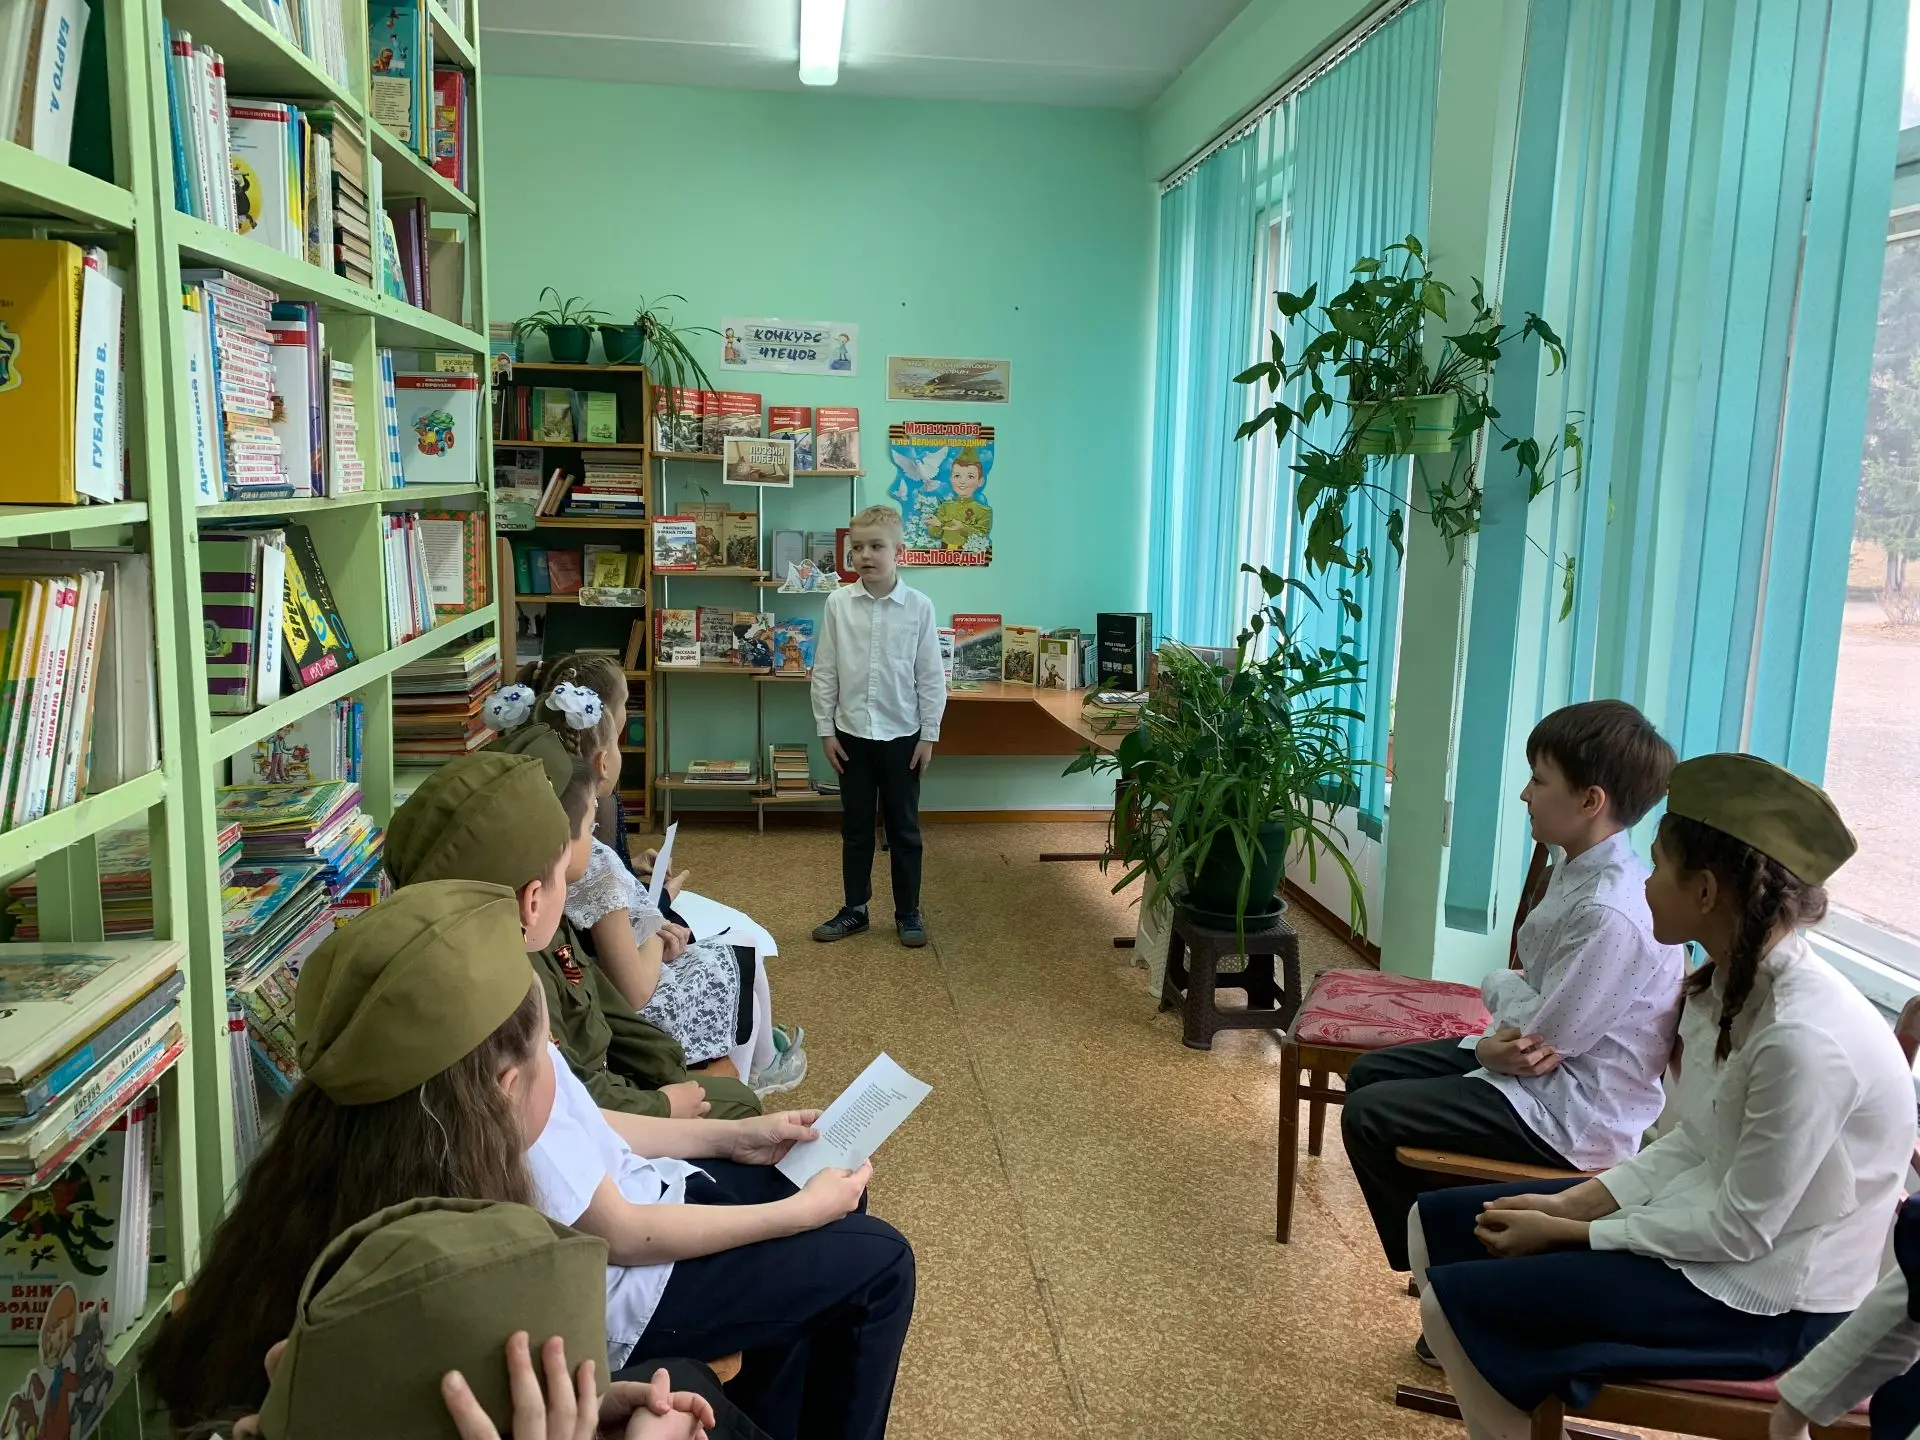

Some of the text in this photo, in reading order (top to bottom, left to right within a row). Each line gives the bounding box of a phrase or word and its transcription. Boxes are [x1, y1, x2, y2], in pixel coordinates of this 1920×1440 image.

[53, 16, 70, 91] БАРТО
[753, 328, 822, 343] КОНКУРС
[759, 346, 817, 361] ЧТЕЦОВ
[92, 342, 108, 469] ГУБАРЕВ В.
[904, 422, 980, 436] Мира и добра
[191, 378, 210, 496] Драгунский
[911, 437, 945, 447] Великий
[946, 439, 987, 448] праздник
[749, 445, 785, 456] ПОЭЗИЯ
[749, 455, 787, 465] ПОБЕДЫ
[897, 549, 985, 566] День Победы!
[266, 624, 275, 673] ОСТЕР
